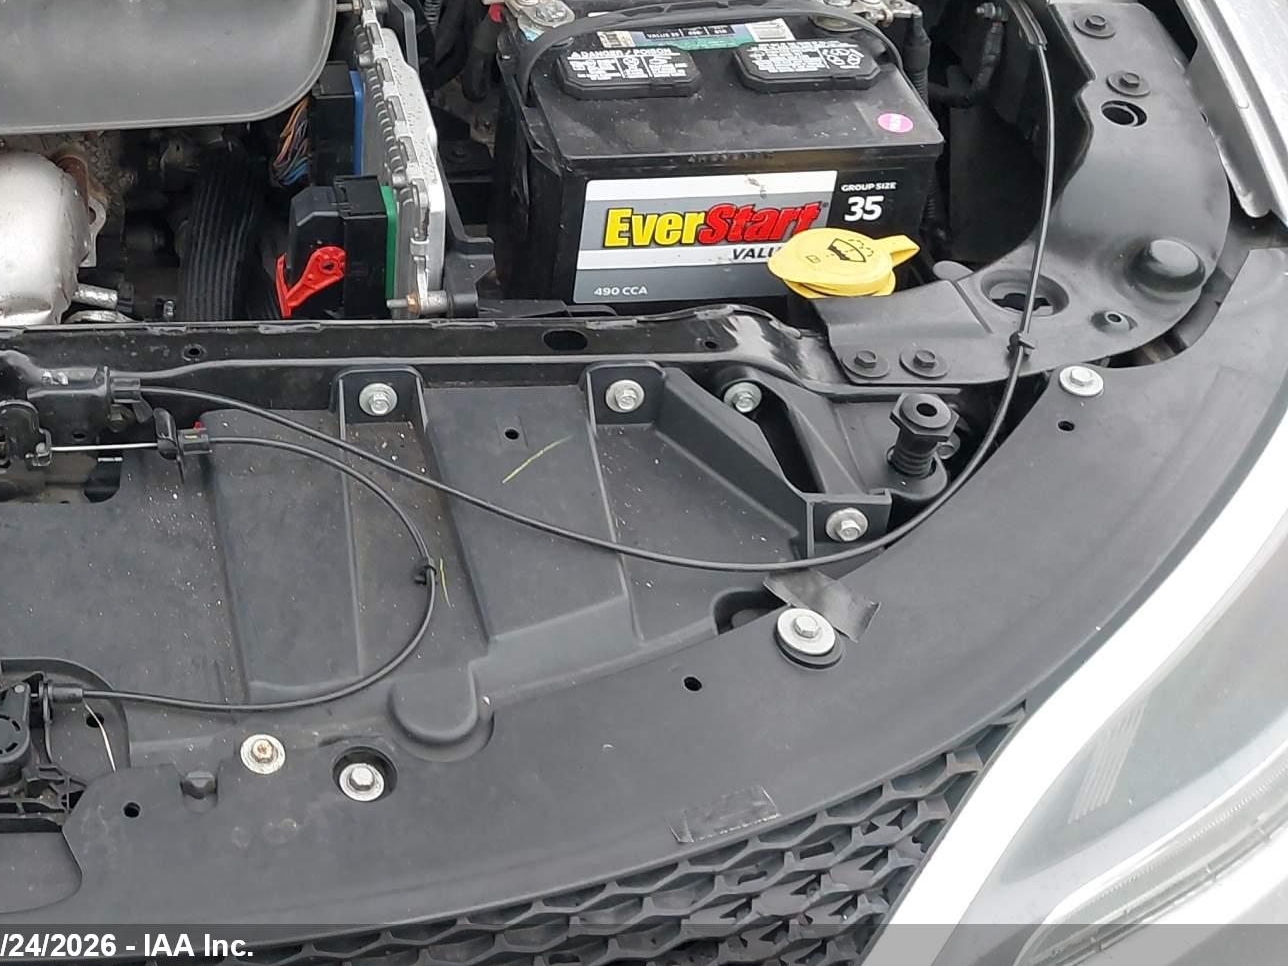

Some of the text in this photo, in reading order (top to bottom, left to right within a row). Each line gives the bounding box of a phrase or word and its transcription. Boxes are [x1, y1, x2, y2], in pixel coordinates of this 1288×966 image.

[876, 182, 897, 190] SIZE
[845, 196, 884, 221] 35
[602, 201, 823, 249] EverStart
[732, 246, 779, 260] VALU
[594, 286, 648, 296] 490 CCA
